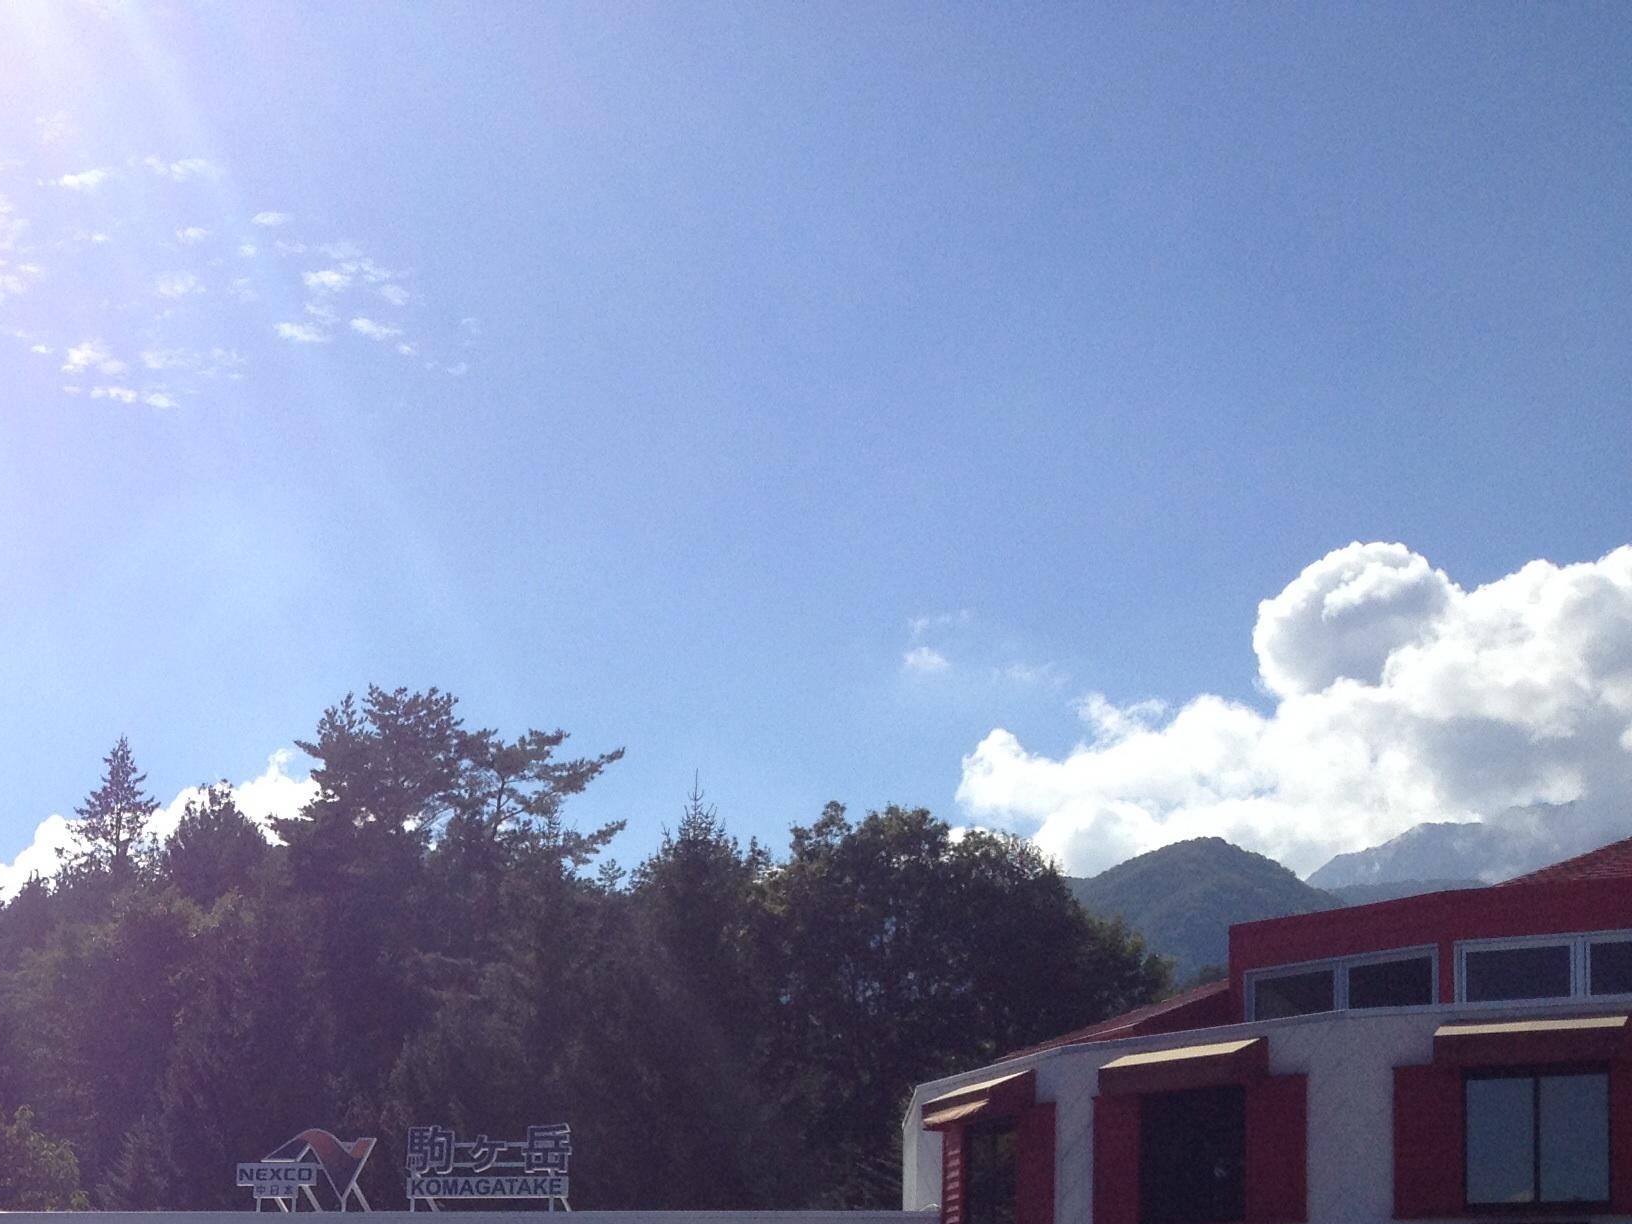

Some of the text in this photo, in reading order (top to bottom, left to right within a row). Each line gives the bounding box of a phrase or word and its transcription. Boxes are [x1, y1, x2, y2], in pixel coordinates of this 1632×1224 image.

[238, 1167, 312, 1182] NEXCO
[255, 1184, 294, 1196] 中日本
[411, 1178, 562, 1196] KOMAGATAKE
